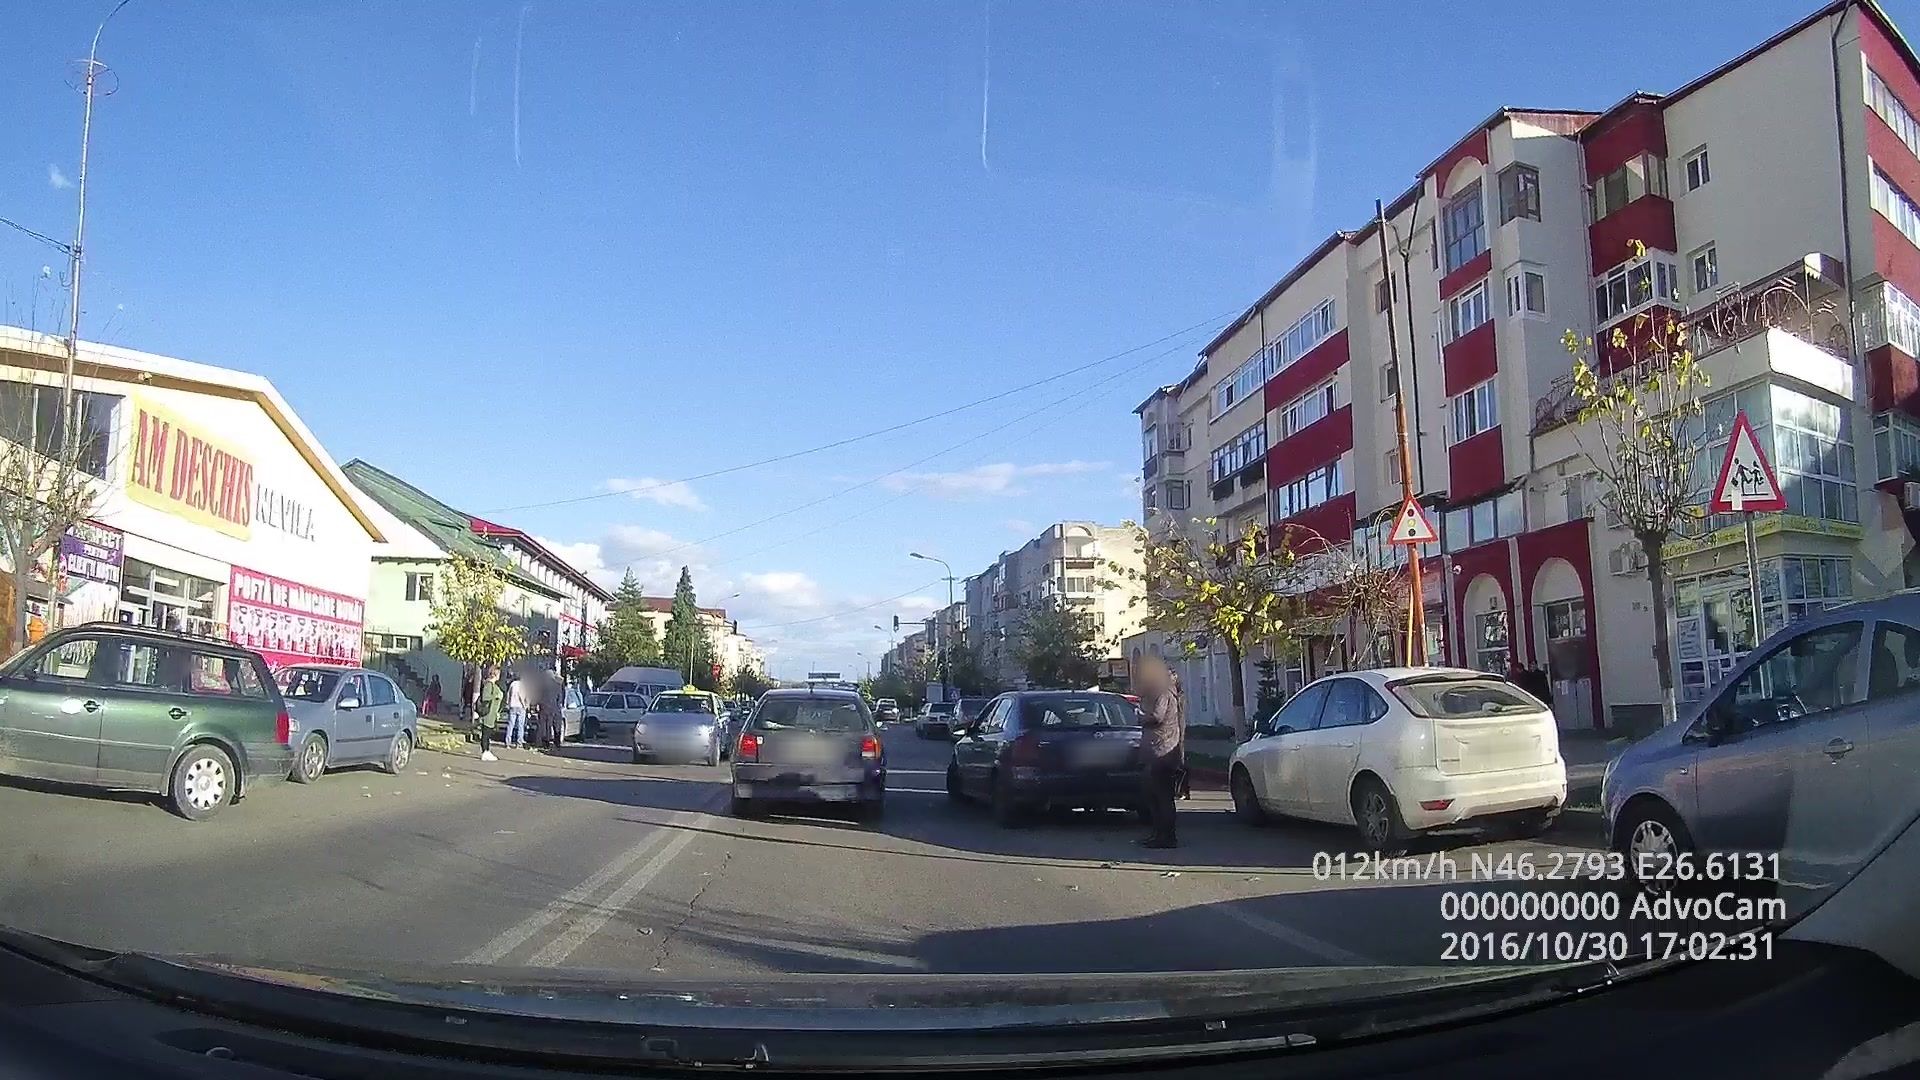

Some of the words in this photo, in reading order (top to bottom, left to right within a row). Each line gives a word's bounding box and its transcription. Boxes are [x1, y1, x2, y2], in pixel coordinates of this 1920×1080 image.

[131, 408, 170, 494] AM
[170, 428, 253, 527] DESCHIS
[273, 582, 289, 608] DE
